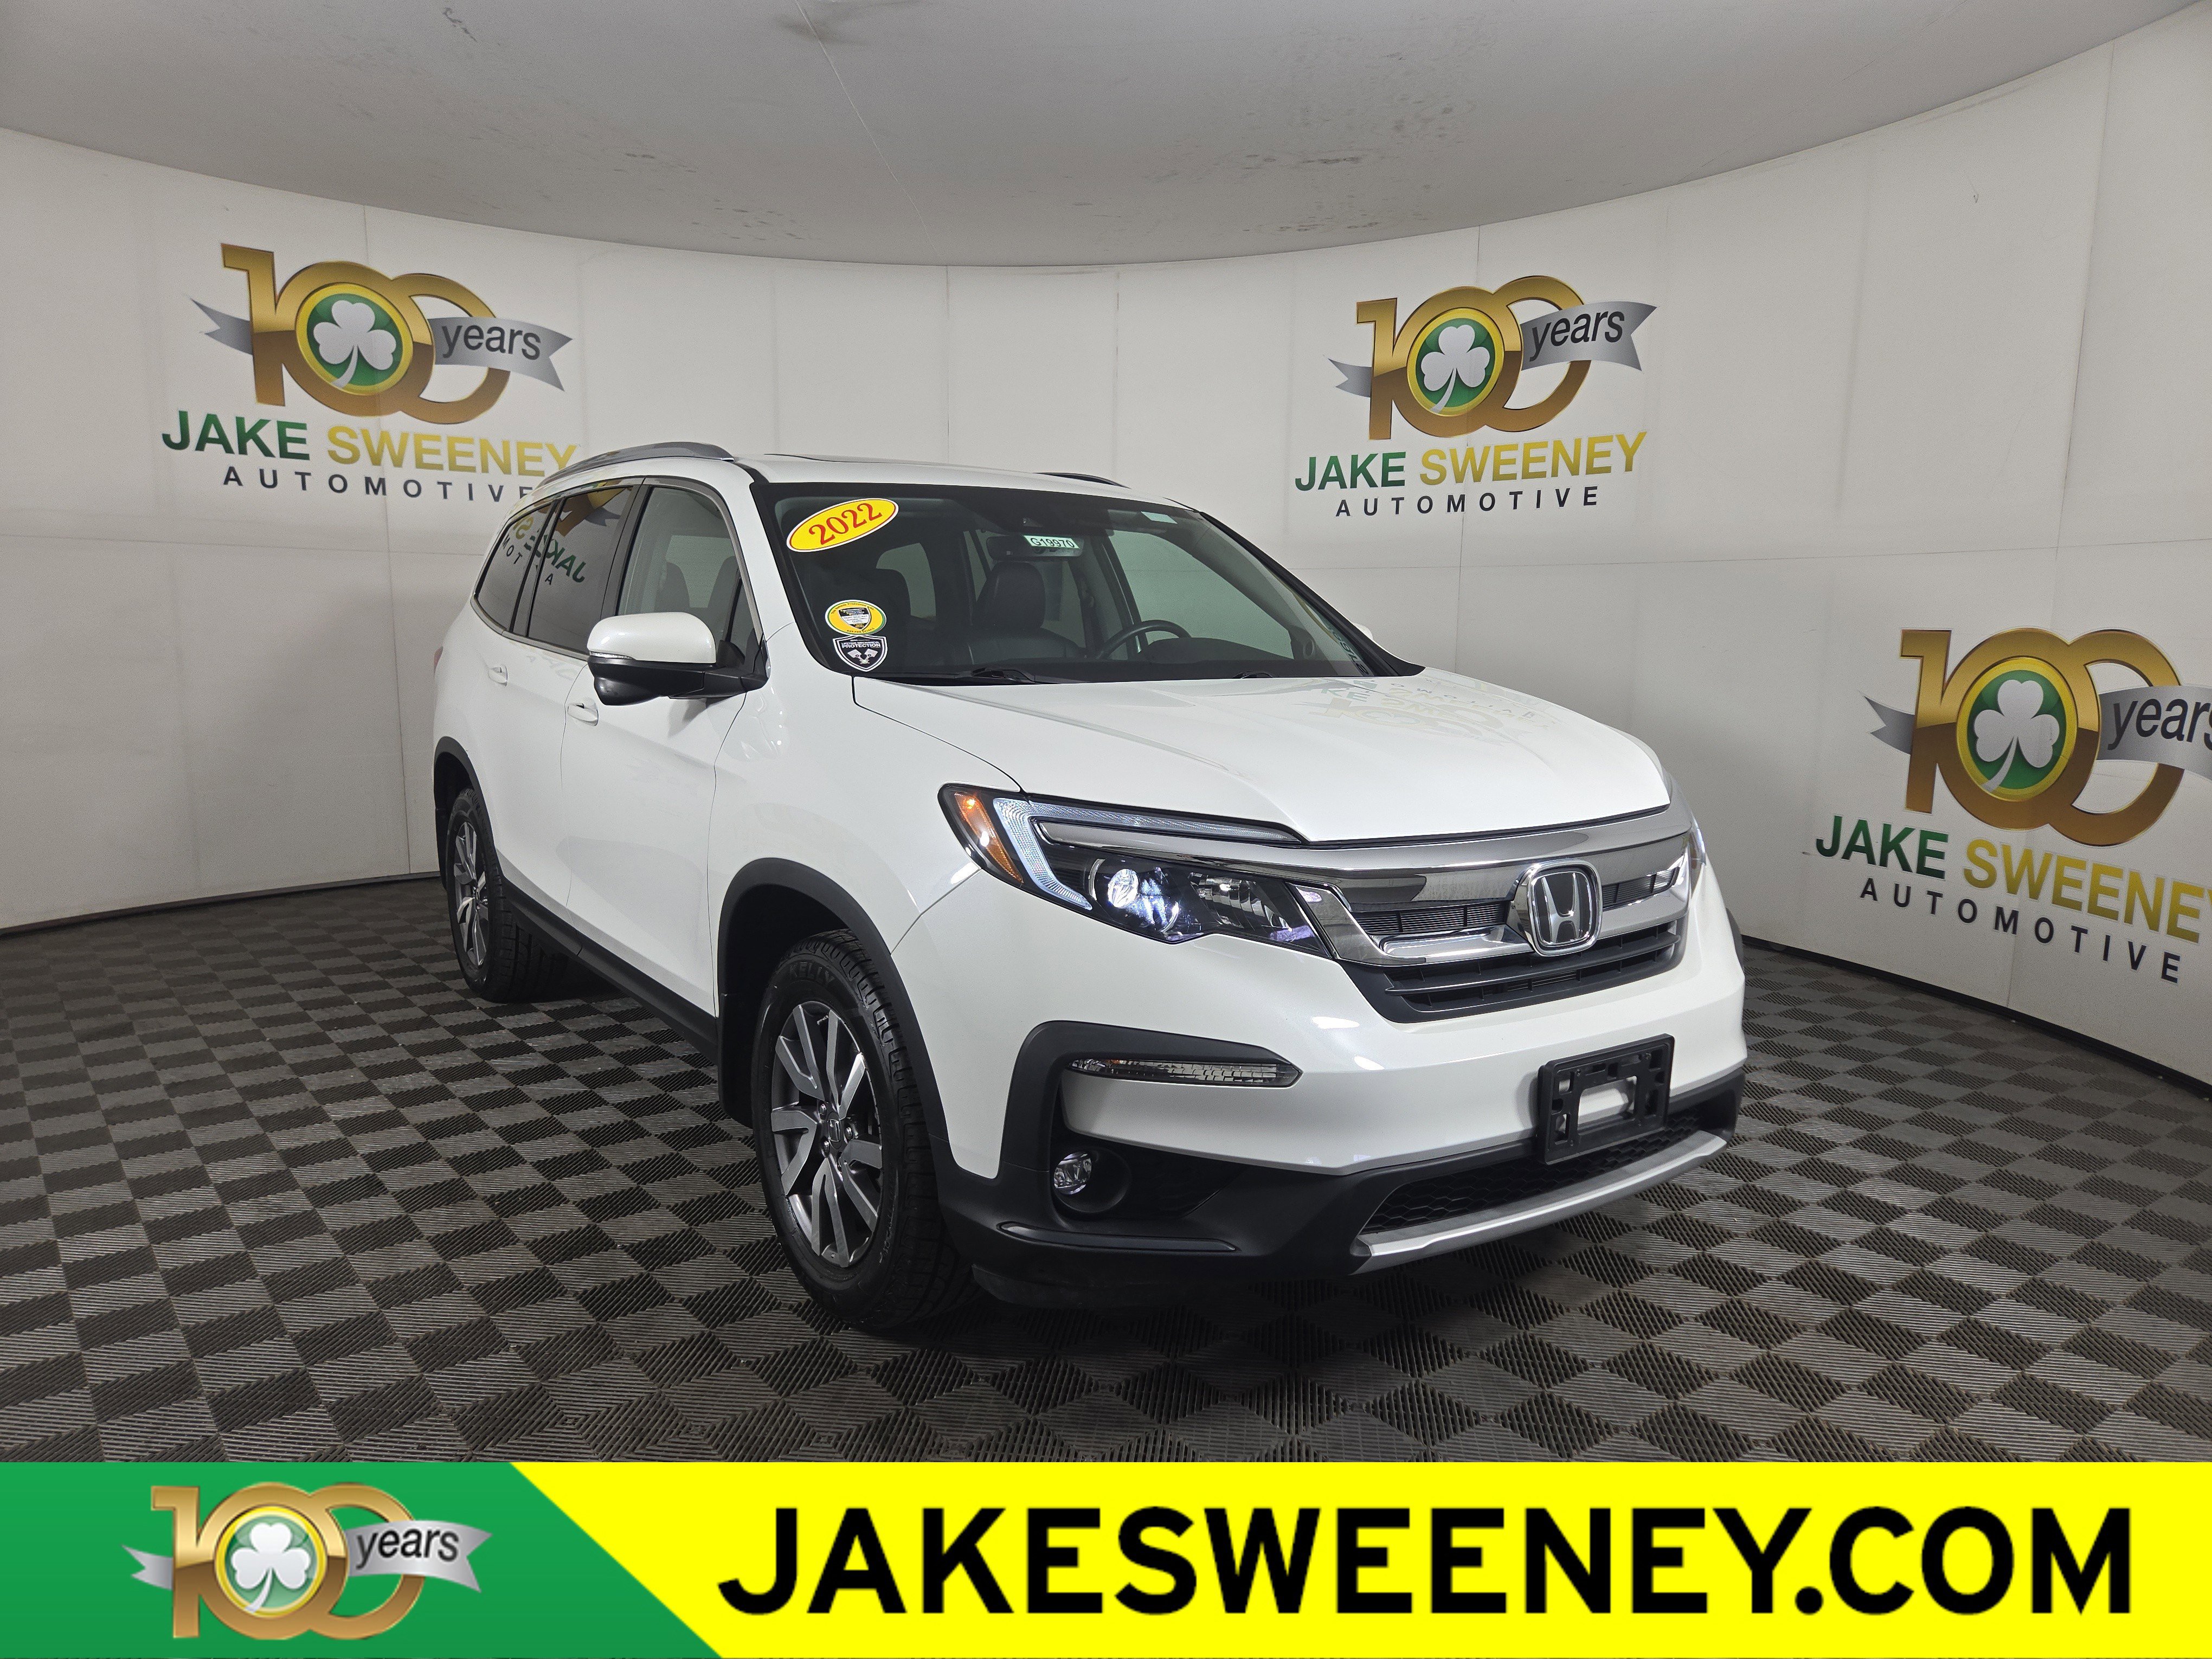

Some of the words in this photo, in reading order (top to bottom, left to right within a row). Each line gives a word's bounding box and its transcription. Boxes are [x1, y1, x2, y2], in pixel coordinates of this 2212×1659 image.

[221, 243, 511, 425] 100
[442, 325, 541, 360] years
[1356, 275, 1592, 441] 100
[1529, 310, 1625, 362] years
[162, 410, 310, 461] JAKE
[327, 426, 577, 477] SWEENEY
[1295, 451, 1406, 491] JAKE
[1419, 431, 1647, 486] SWEENEY
[809, 503, 882, 545] 2022
[1030, 537, 1075, 548] G19970
[1335, 486, 1598, 517] AUTOMOTIVE
[1900, 627, 2185, 847] 100
[2107, 698, 2212, 750] year
[1816, 815, 1949, 880] JAKE
[1963, 839, 2212, 944] SWEENE
[1860, 878, 2181, 983] AUTOMOTIVE
